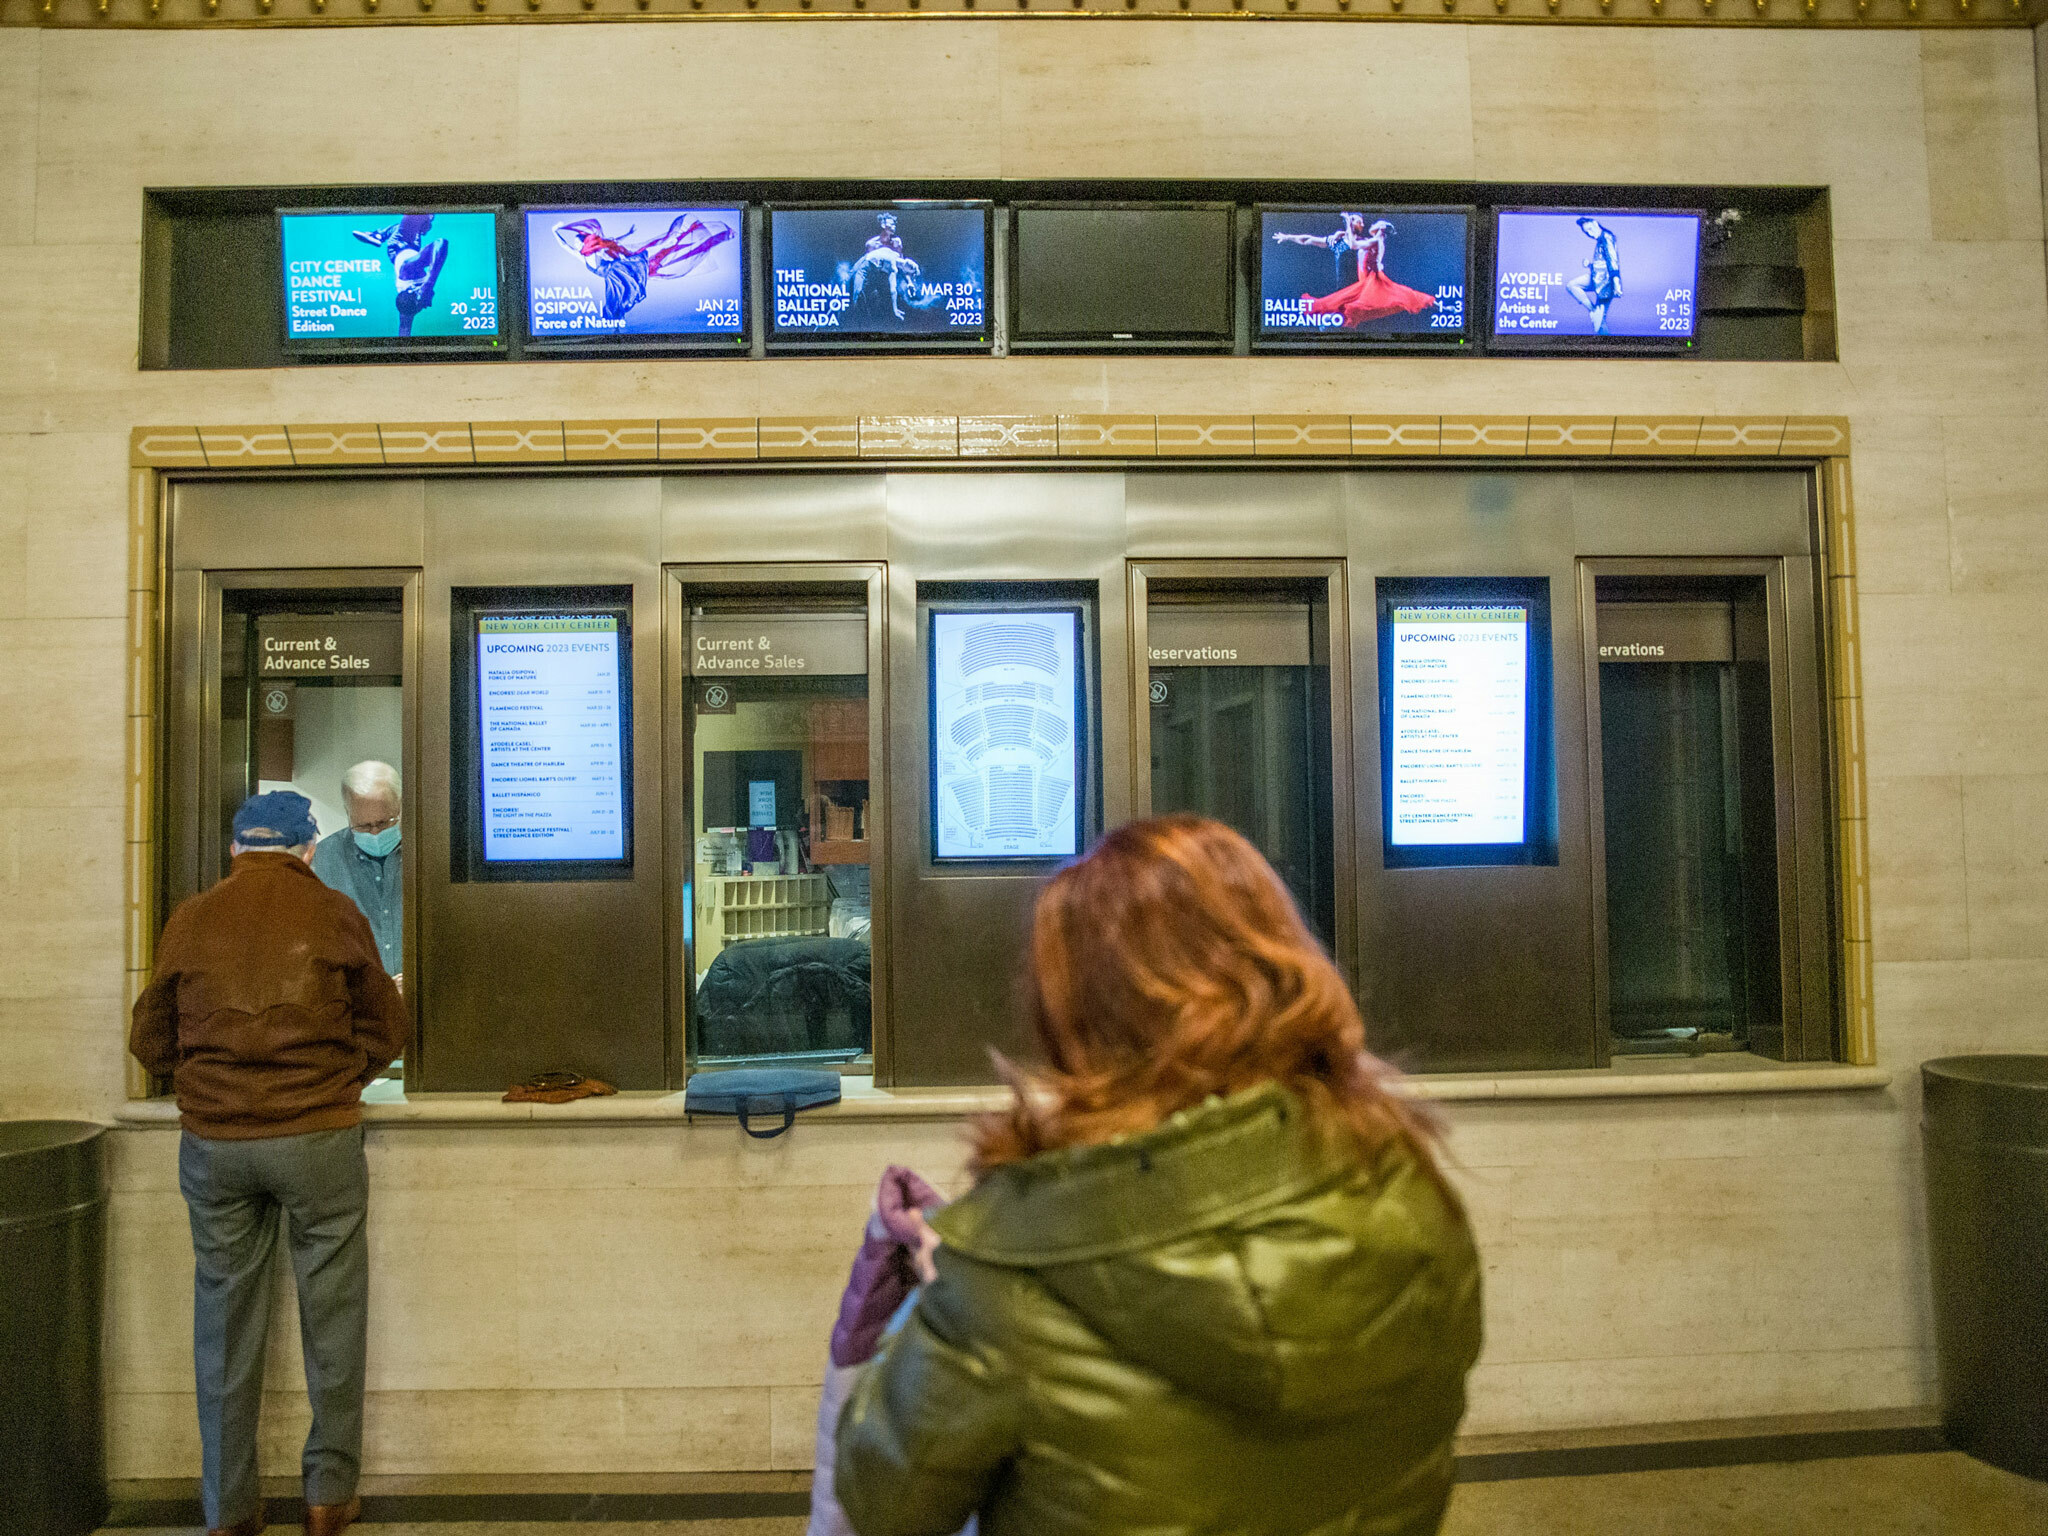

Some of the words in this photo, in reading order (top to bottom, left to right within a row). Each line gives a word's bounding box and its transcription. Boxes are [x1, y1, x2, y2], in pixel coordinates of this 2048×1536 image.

[289, 261, 322, 273] CITY
[324, 259, 381, 272] CENTER
[290, 275, 342, 288] DANCE
[776, 269, 804, 283] THE
[1499, 272, 1563, 285] AYODELE
[291, 289, 356, 302] FESTIVAL
[470, 287, 495, 300] JUL
[534, 286, 593, 300] NATALIA
[776, 284, 850, 297] NATIONAL
[921, 283, 953, 296] MAR
[955, 283, 973, 296] 30
[1434, 285, 1463, 298] JUN
[1500, 286, 1542, 300] CASEL
[1664, 288, 1691, 302] APR
[291, 305, 328, 317] Street
[330, 304, 368, 317] Dance
[450, 302, 468, 315] 20
[479, 302, 495, 314] 22
[534, 301, 598, 315] OSIPOVA
[695, 299, 723, 312] JAN
[726, 298, 739, 311] 21
[777, 299, 827, 312] BALLET
[829, 299, 850, 312] OF
[945, 298, 975, 311] APR
[977, 298, 982, 311] 1
[1264, 298, 1314, 312] BALLET
[1498, 302, 1537, 314] Artists
[1538, 304, 1550, 314] at
[1655, 303, 1668, 316] 13
[1678, 303, 1690, 316] 15
[463, 316, 496, 329] 2023
[535, 316, 567, 329] Force
[569, 316, 583, 329] of
[585, 315, 626, 328] Nature
[706, 313, 740, 327] 2023
[777, 313, 839, 327] CANADA
[950, 312, 982, 325] 2023
[1430, 314, 1462, 327] 2023
[1498, 315, 1518, 328] the
[1519, 316, 1558, 329] Center
[1659, 317, 1690, 330] 2023
[292, 319, 335, 332] Edition
[1400, 612, 1422, 620] NEW
[1455, 611, 1478, 619] CITY
[1481, 611, 1520, 619] CENTER
[486, 622, 509, 630] NEW
[512, 622, 540, 630] YORK
[543, 621, 566, 629] CITY
[569, 621, 610, 629] CENTER
[264, 637, 320, 651] Current
[324, 636, 337, 651] &
[696, 637, 754, 651] Current
[758, 636, 771, 650] &
[1400, 634, 1455, 642] UPCOMING
[1458, 634, 1479, 642] 2023
[1482, 633, 1519, 642] EVENTS
[487, 644, 544, 653] UPCOMING
[546, 643, 569, 652] 2023
[571, 643, 610, 652] EVENTS
[264, 655, 326, 670] Advance
[330, 655, 370, 669] Sales
[696, 655, 760, 669] Advance
[764, 654, 805, 669] Sales
